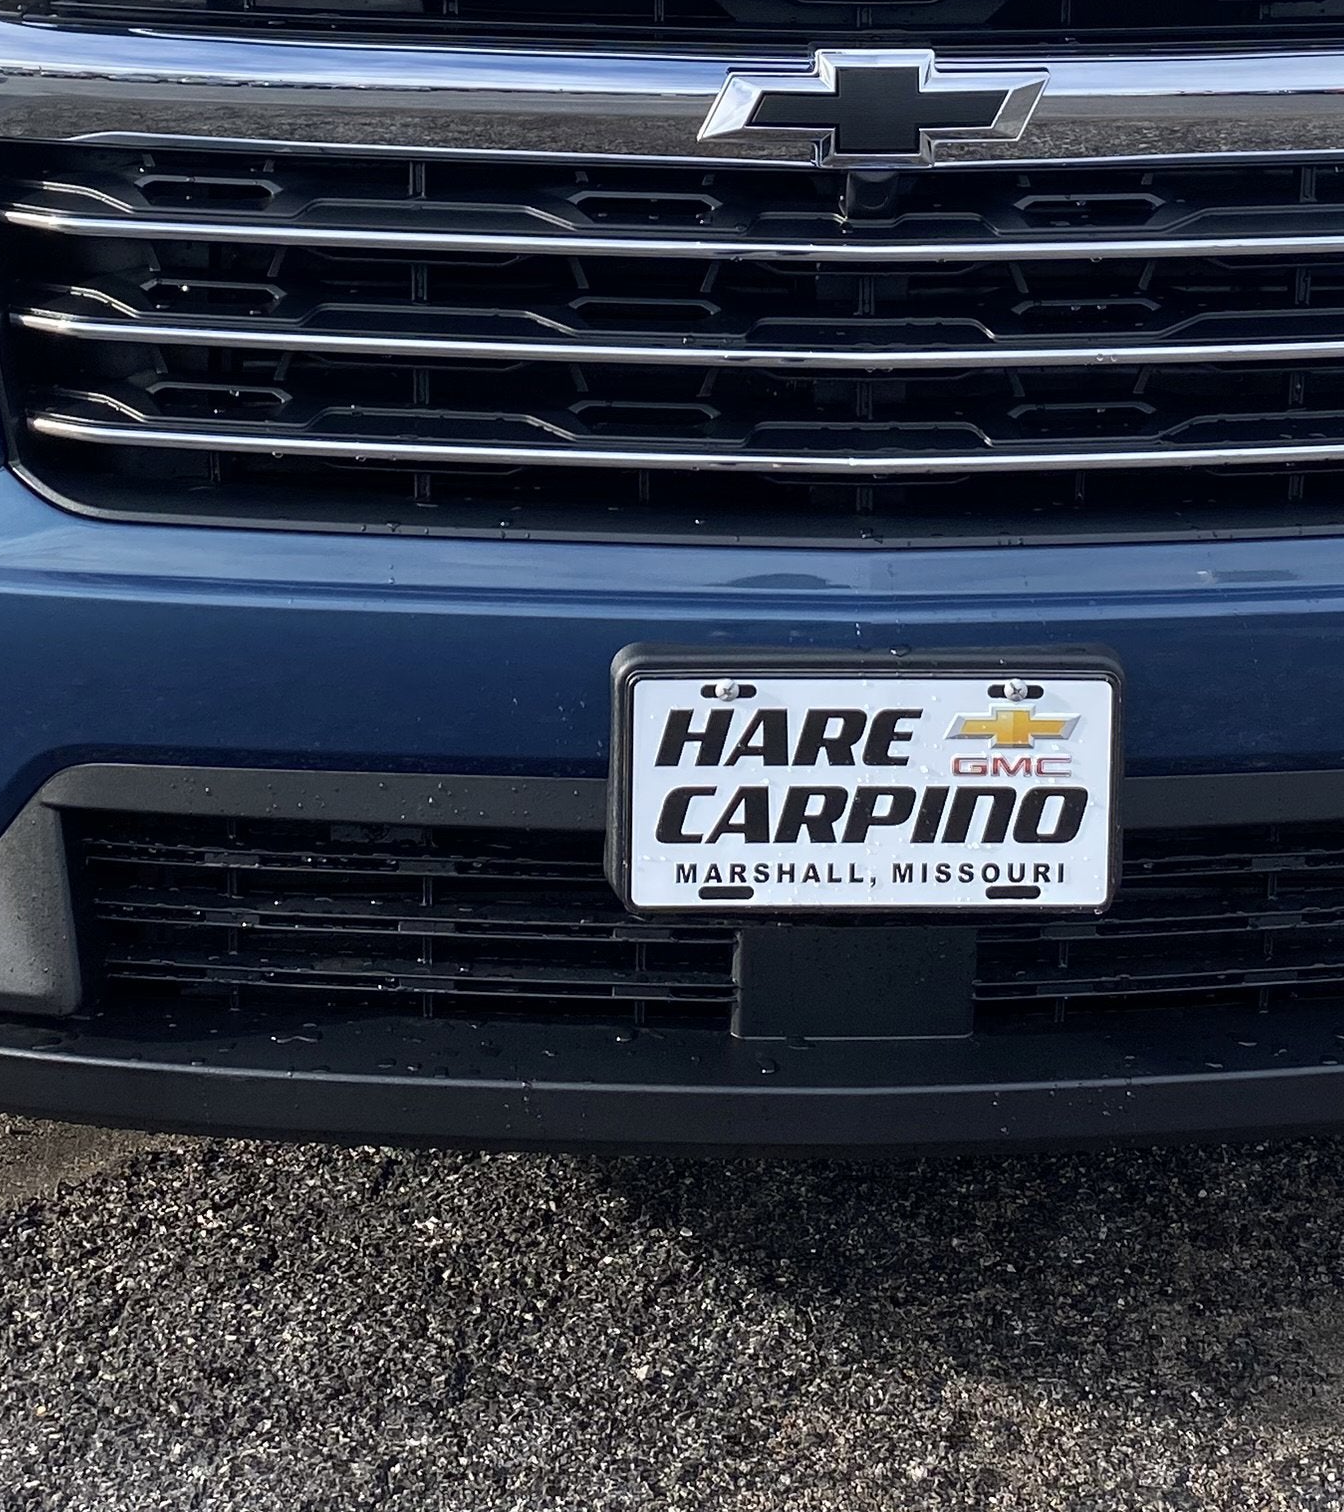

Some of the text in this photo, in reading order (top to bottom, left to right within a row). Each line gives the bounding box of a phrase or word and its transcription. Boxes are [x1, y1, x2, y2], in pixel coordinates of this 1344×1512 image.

[654, 708, 923, 767] HARE
[951, 753, 1073, 778] GMC
[655, 785, 1089, 845] CARPINO
[675, 862, 1065, 888] MARSHALL, MISSOURI
